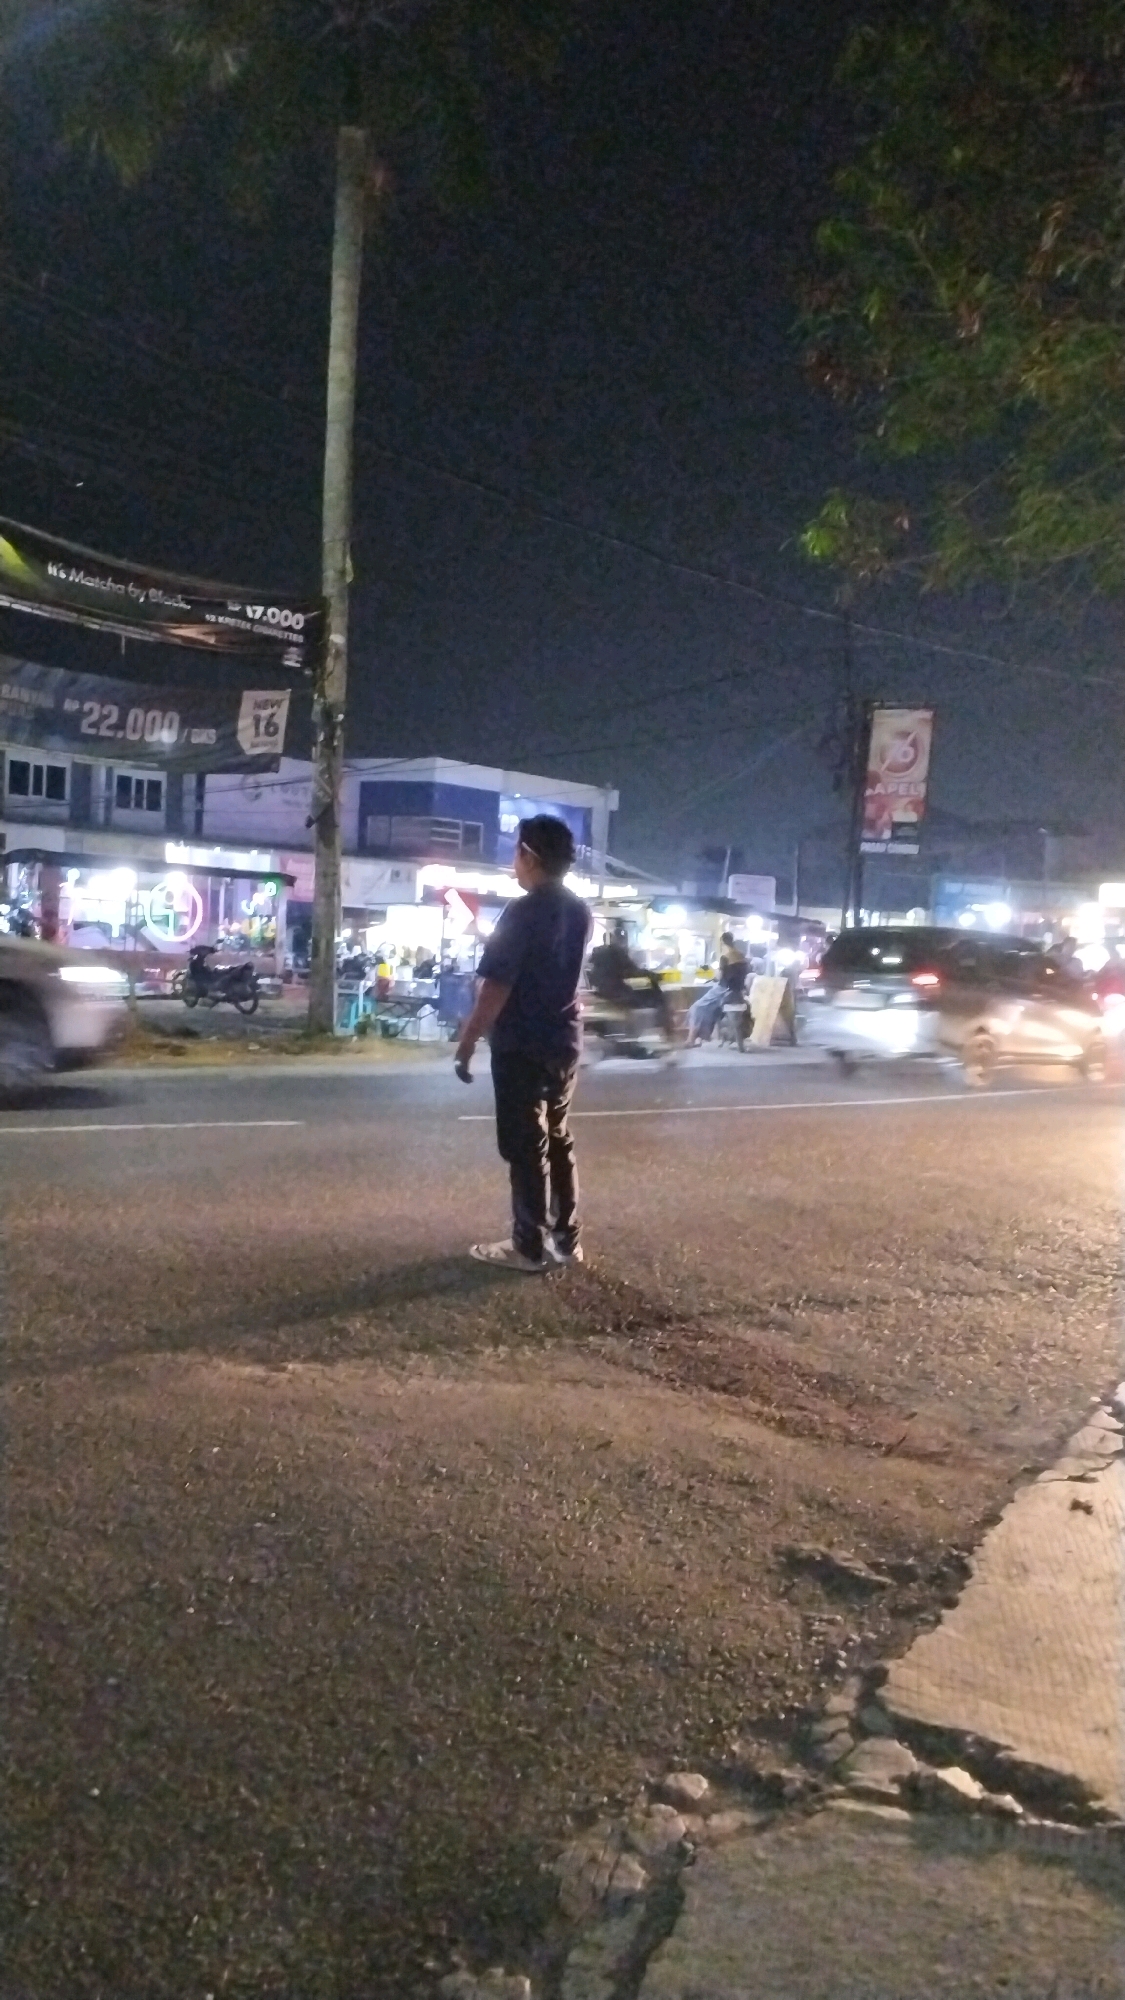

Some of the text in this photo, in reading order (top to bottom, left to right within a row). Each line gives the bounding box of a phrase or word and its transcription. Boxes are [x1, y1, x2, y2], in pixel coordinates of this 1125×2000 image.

[47, 560, 65, 579] It's
[68, 567, 126, 594] Matcha
[127, 581, 146, 603] by
[245, 604, 305, 630] 17.000
[80, 701, 180, 744] 22.000
[252, 711, 280, 738] 16
